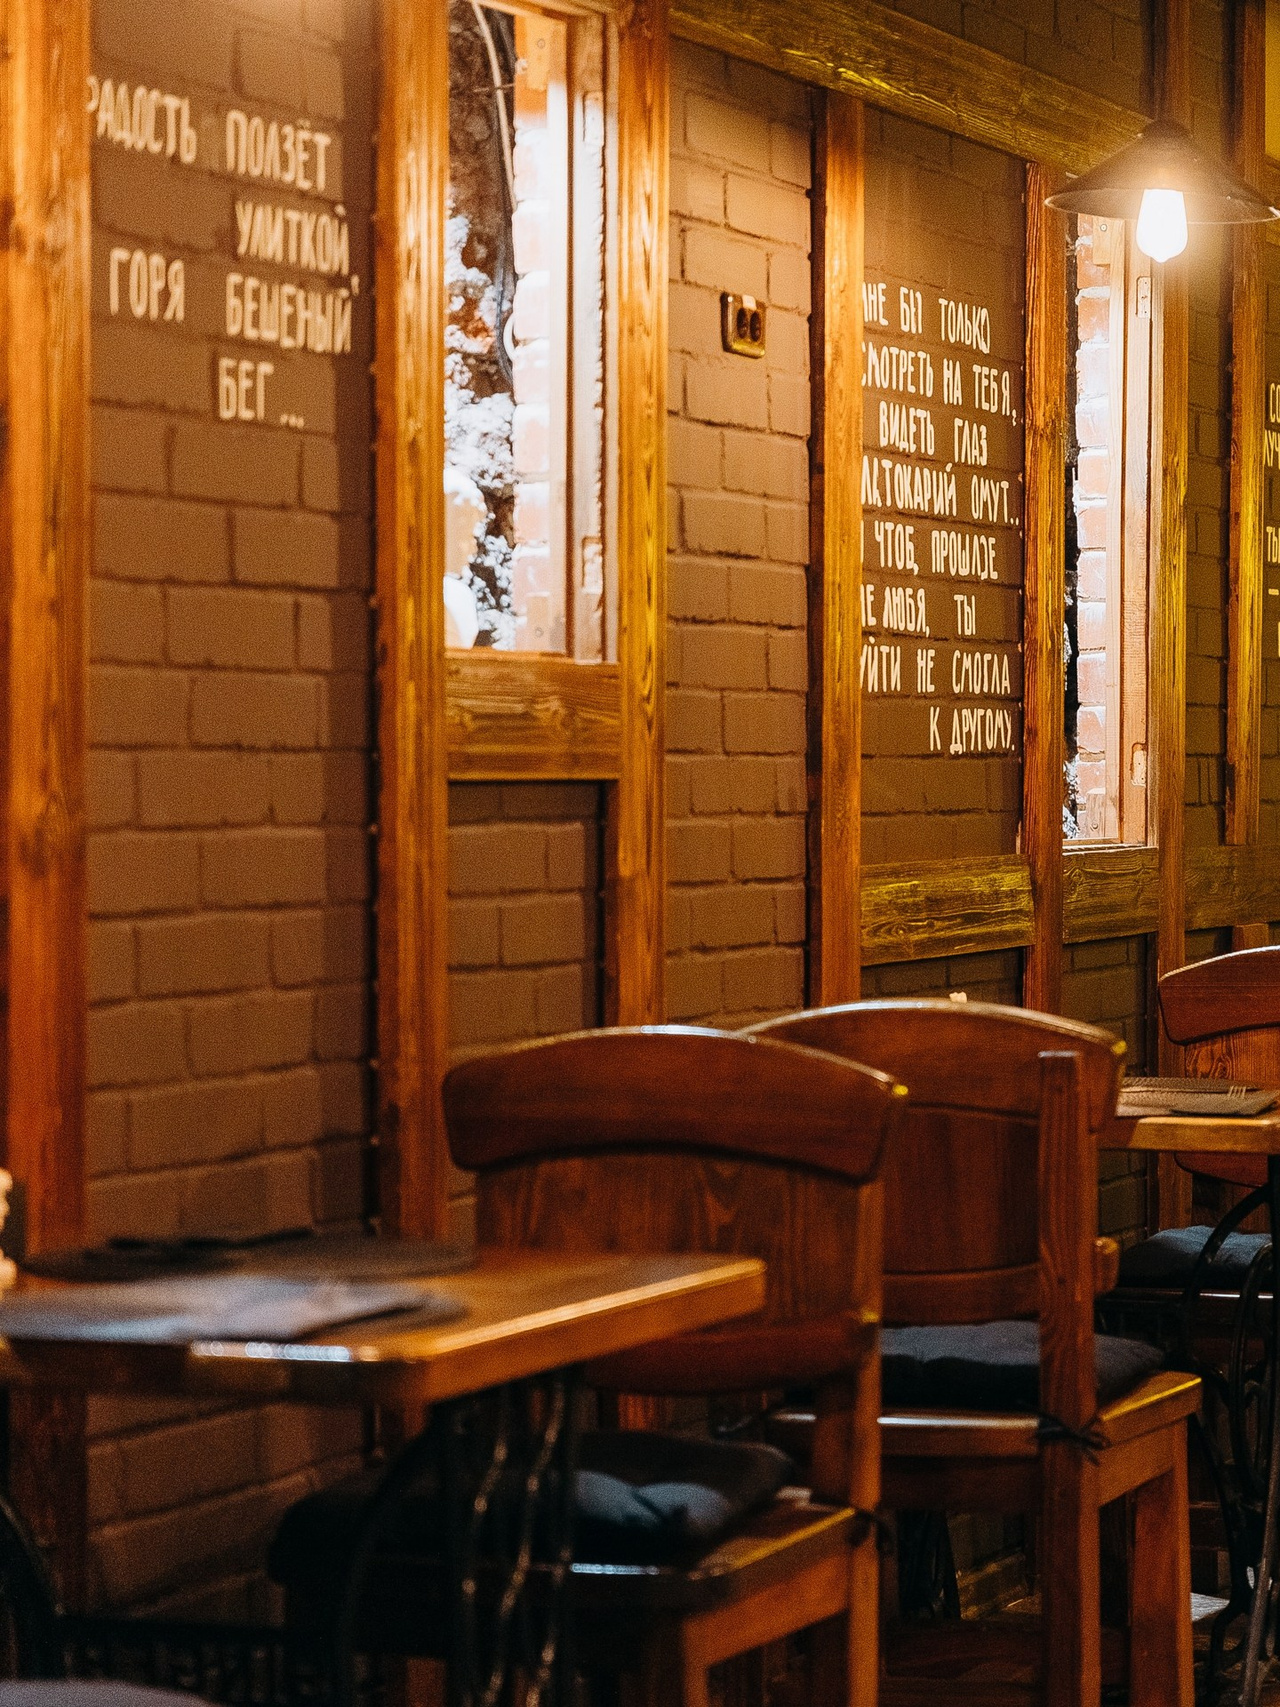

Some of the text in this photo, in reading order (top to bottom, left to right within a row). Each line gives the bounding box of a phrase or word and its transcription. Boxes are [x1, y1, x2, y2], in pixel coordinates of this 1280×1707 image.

[110, 247, 185, 322] ГОРЯ
[938, 298, 990, 353] ТОЛЬКО
[943, 358, 962, 405] НА
[879, 401, 987, 466] ВИДЕТЬ ГЛАЗ
[874, 520, 919, 575] ЧТОБ,
[1266, 526, 1280, 564] ТЫ
[883, 586, 930, 638] ЛЮБЯ,
[954, 594, 976, 635] ТЫ
[917, 648, 935, 693] НЕ
[952, 650, 1010, 694] СМОГЛА
[930, 706, 941, 751] К
